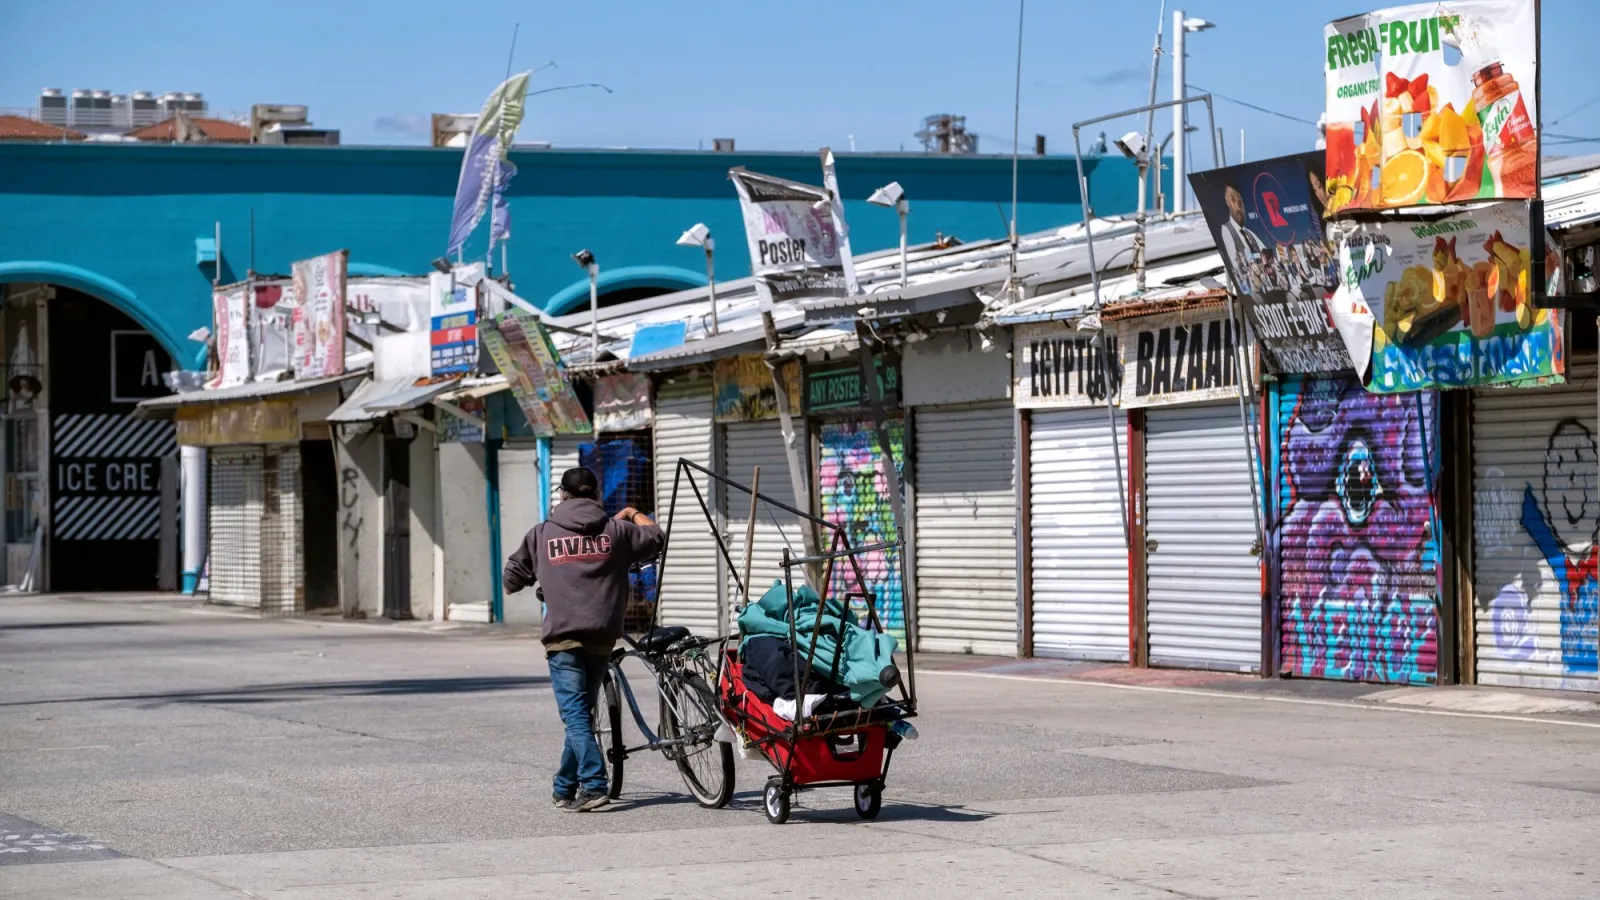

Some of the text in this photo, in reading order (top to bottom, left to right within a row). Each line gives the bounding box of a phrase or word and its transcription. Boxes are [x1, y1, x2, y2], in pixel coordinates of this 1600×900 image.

[1379, 15, 1460, 57] FRUIT
[1337, 80, 1368, 99] ORGANIC
[758, 238, 806, 265] Poster
[1344, 232, 1391, 248] Add a Zing
[140, 349, 159, 387] A
[1031, 318, 1240, 401] EGYPTIAN BAZAAR
[810, 379, 826, 405] ANY
[828, 373, 860, 401] POSTER
[58, 463, 161, 491] ICE CRE
[547, 534, 612, 560] HVAC
